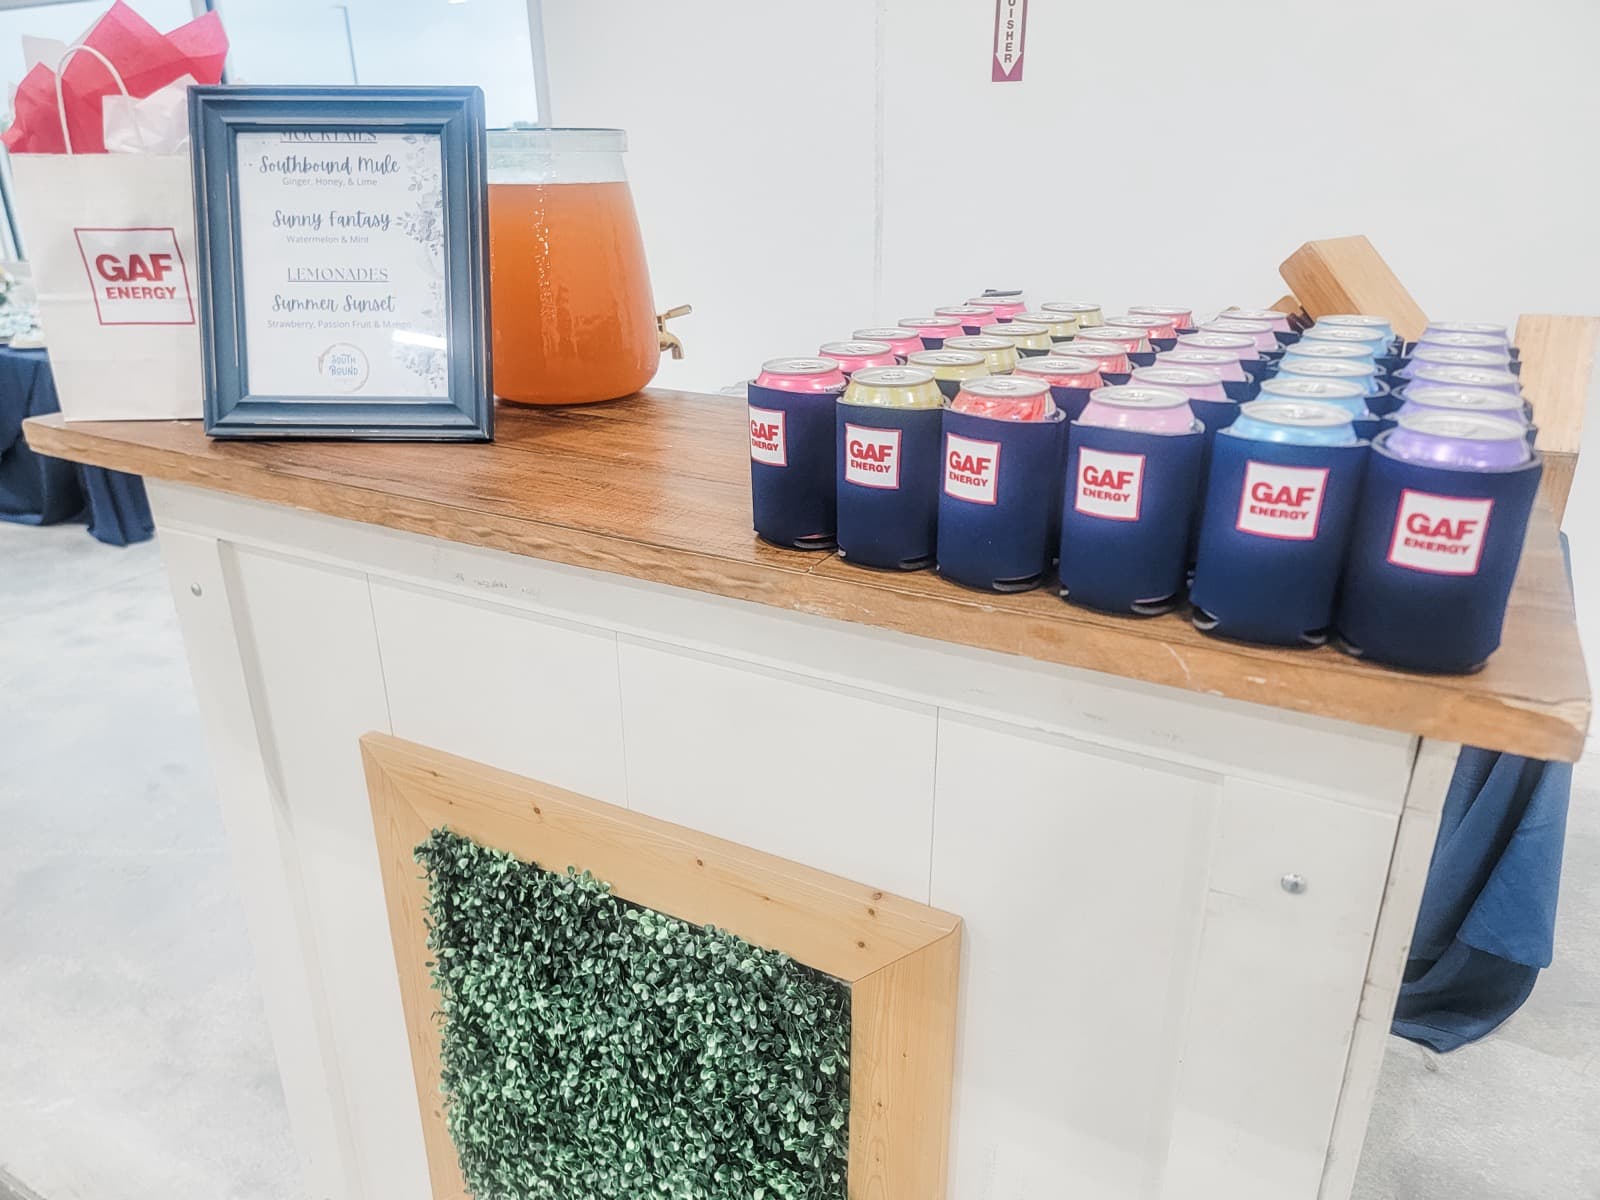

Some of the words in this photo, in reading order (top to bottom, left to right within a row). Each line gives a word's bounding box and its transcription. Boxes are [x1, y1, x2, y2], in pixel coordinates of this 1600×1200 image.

[259, 154, 352, 175] Southbound
[357, 154, 401, 175] Mule
[282, 177, 311, 187] Ginger,
[315, 177, 345, 188] Honey,
[347, 177, 354, 186] &
[356, 177, 378, 186] Lime
[272, 209, 323, 231] Sunny
[329, 209, 392, 231] Fantasy
[286, 235, 340, 244] Watermelon
[341, 235, 348, 244] &
[349, 235, 369, 244] Mint
[95, 253, 172, 282] GAF
[287, 267, 390, 282] LEMONADES
[105, 286, 177, 300] ENERGY
[272, 294, 339, 313] Summer
[342, 294, 397, 313] Sunset
[267, 319, 316, 329] Strawberry,
[318, 319, 350, 329] Passion
[352, 319, 372, 329] Fruit
[374, 319, 381, 328] &
[750, 419, 779, 441] GAF
[849, 439, 893, 462] GAF
[850, 459, 891, 473] ENERGY
[949, 450, 991, 475] GAF
[949, 471, 988, 487] ENERGY
[1083, 465, 1134, 490] GAF
[1082, 487, 1131, 502] ENERGY
[1251, 481, 1316, 507] GAF
[1249, 504, 1310, 520] ENERGY
[1406, 512, 1478, 540] GAF
[1403, 537, 1471, 555] ENERGY
